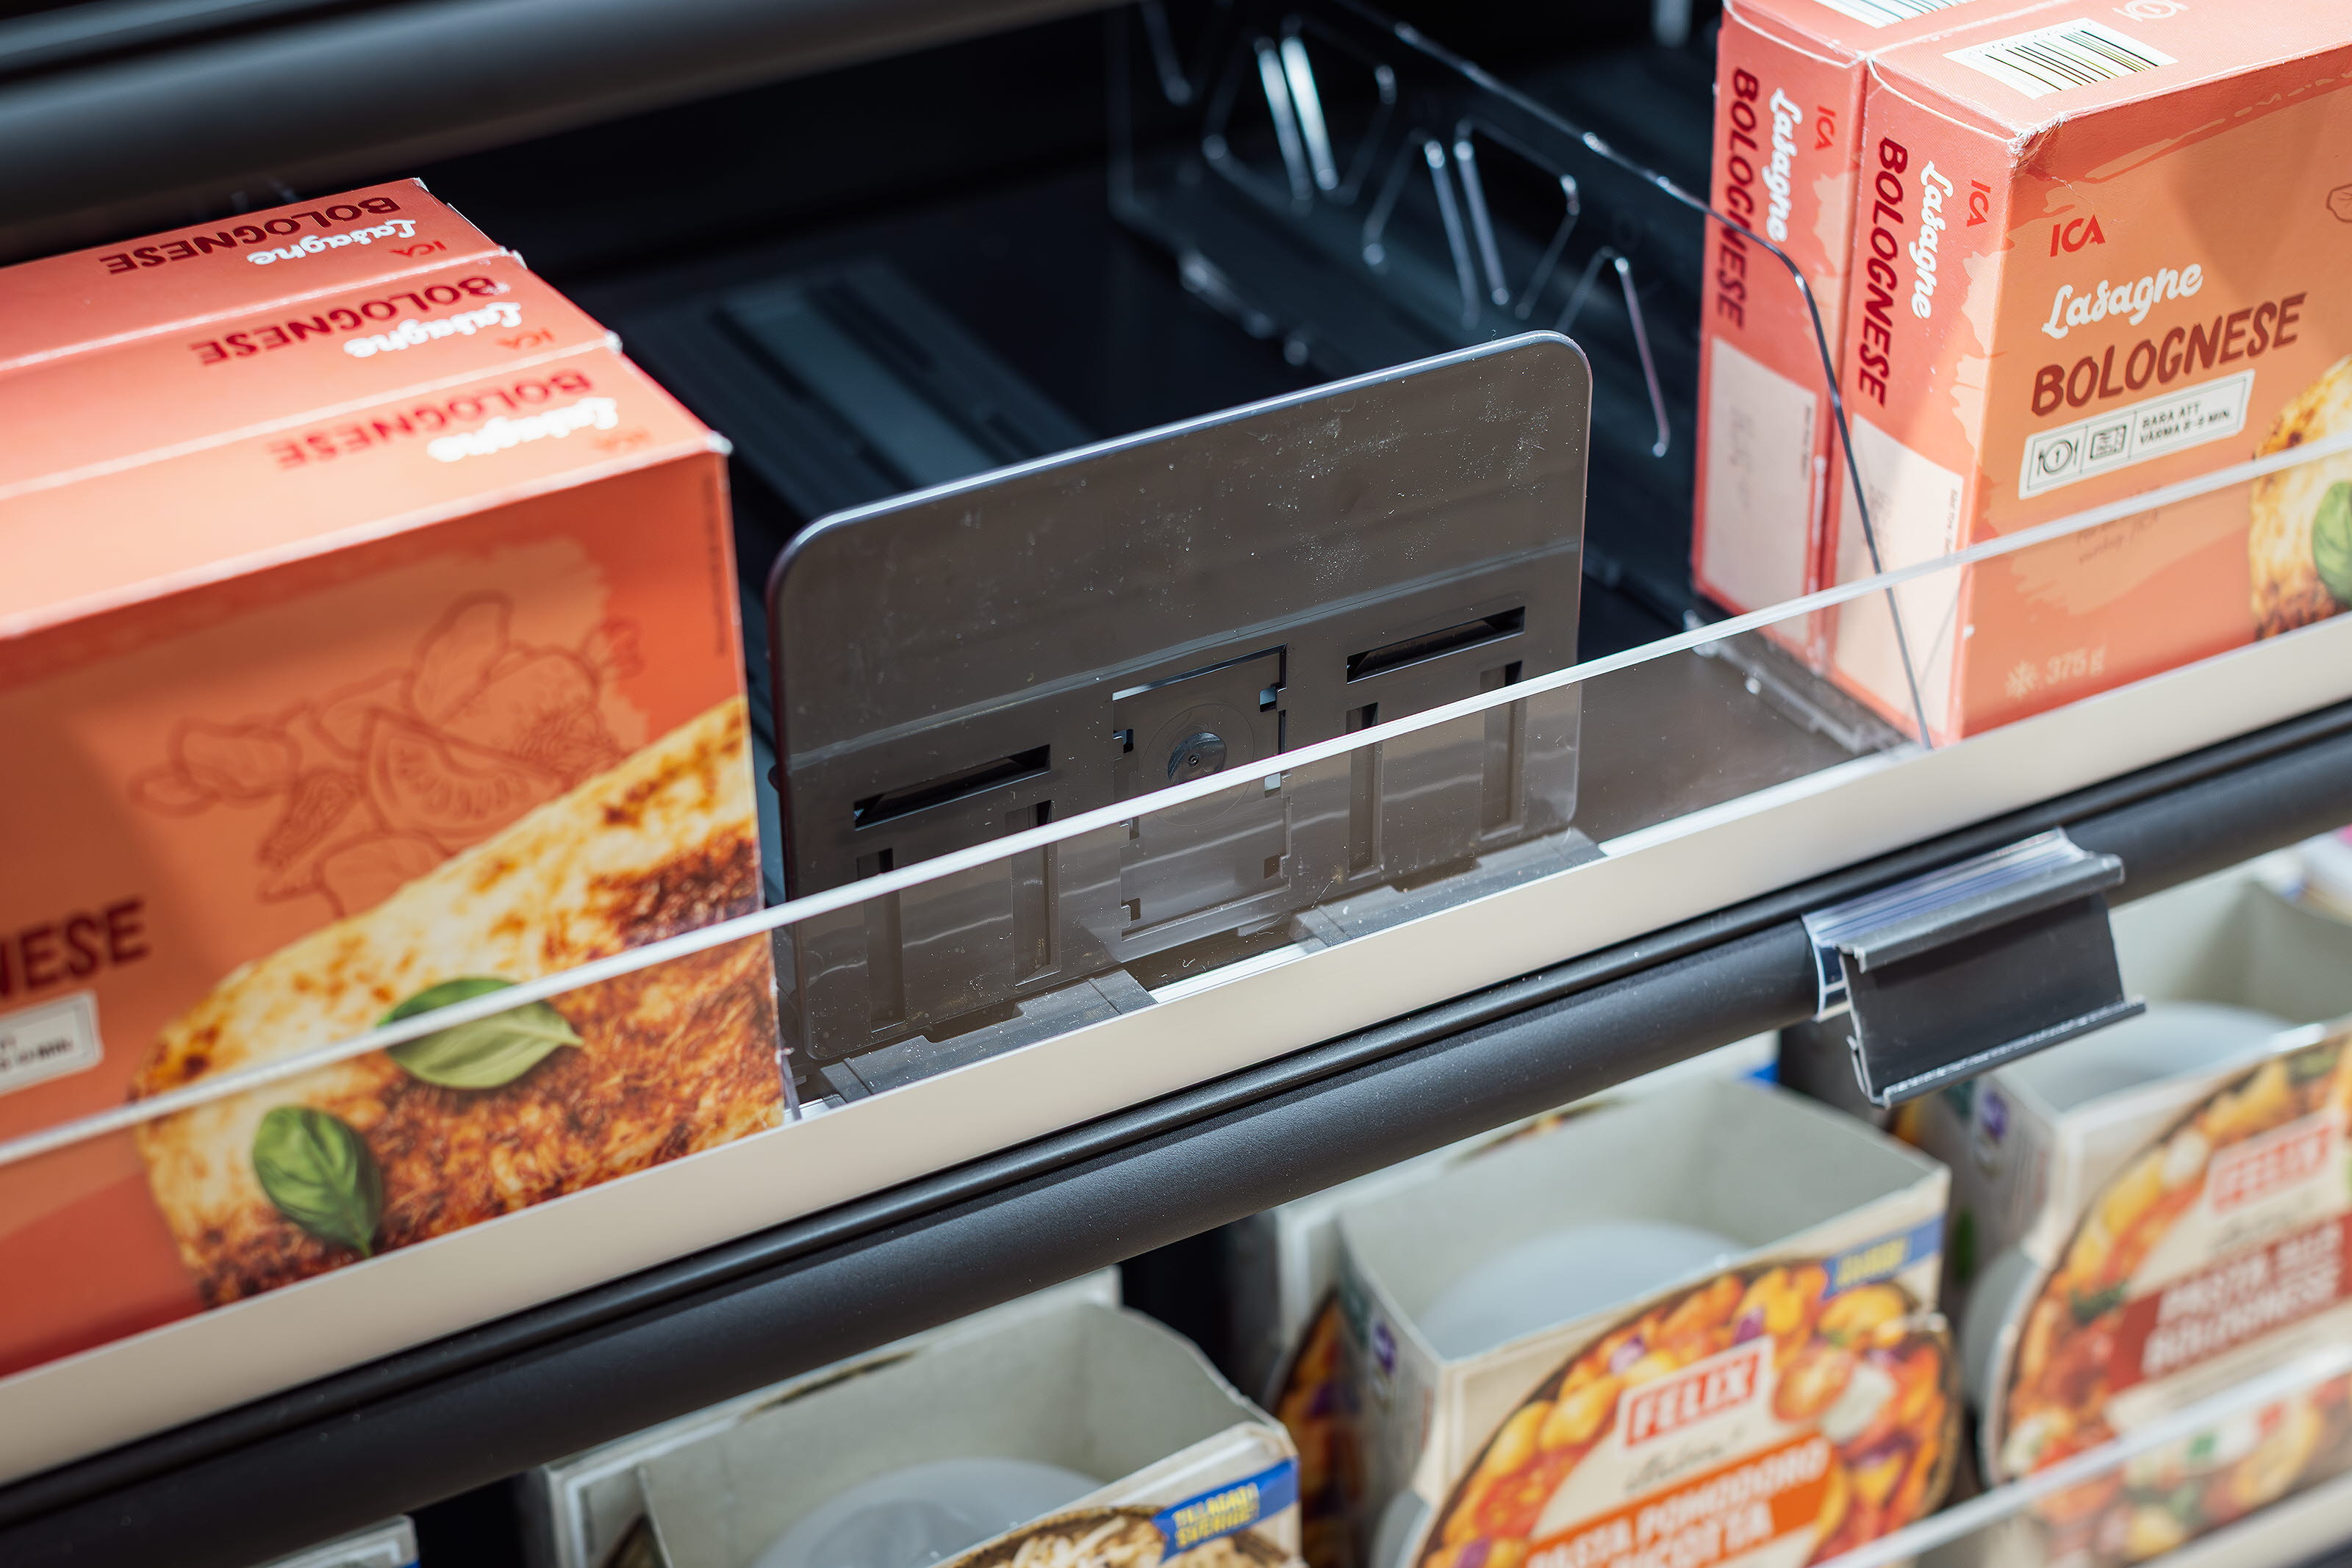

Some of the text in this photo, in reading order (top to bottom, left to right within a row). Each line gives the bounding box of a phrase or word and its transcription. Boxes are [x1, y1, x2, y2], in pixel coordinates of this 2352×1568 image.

[1761, 87, 1803, 242] Lasagne
[1814, 105, 1837, 151] ICA
[98, 196, 403, 276] BOLOGNESE
[1717, 68, 1760, 330] BOLOGNESE
[1908, 159, 1954, 320] Lasagne
[1966, 179, 1992, 228] ICA
[2049, 213, 2107, 257] ICA
[245, 219, 417, 266] Lasagne
[387, 240, 448, 260] ICA
[1858, 136, 1909, 410] BOLOGNESE
[187, 276, 507, 367] BOLOGNESE
[343, 301, 521, 359] Lasagne
[2040, 262, 2204, 340] Lasagne
[2031, 291, 2309, 417] BOLOGNESE
[268, 370, 594, 472] BOLOGNESE
[1630, 1357, 1757, 1439] FELIX
